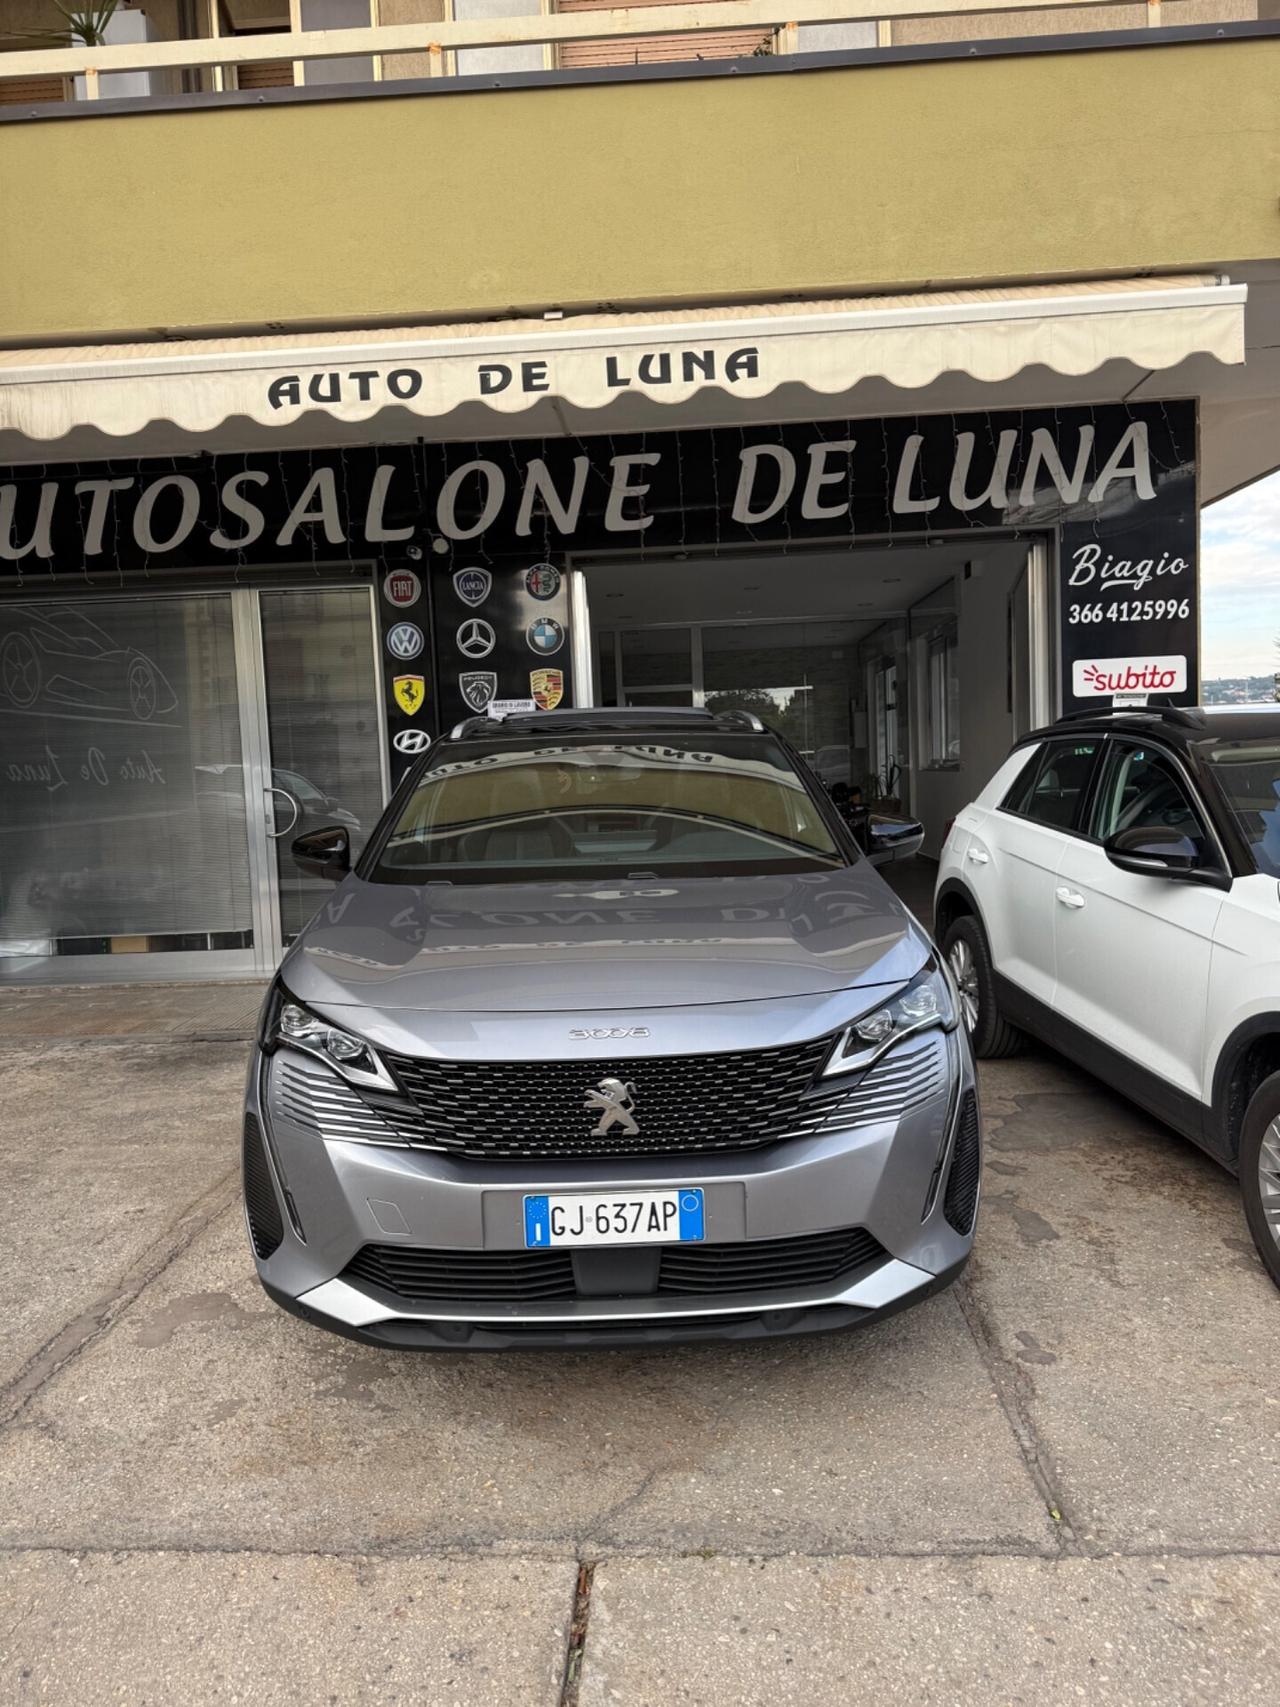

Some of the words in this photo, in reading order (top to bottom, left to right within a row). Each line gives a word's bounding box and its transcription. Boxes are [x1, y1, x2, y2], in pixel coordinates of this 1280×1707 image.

[268, 368, 423, 410] AUTO
[478, 361, 550, 395] DE
[606, 347, 760, 388] LUNA
[731, 440, 856, 524] DE
[893, 421, 1157, 514] LUNA
[1068, 543, 1190, 591] Biagio
[392, 580, 413, 597] FIAT
[461, 581, 485, 592] LANCIA
[1068, 603, 1103, 624] 366
[1106, 599, 1190, 622] 4125996
[1093, 664, 1177, 692] subito
[569, 1027, 651, 1040] 3008
